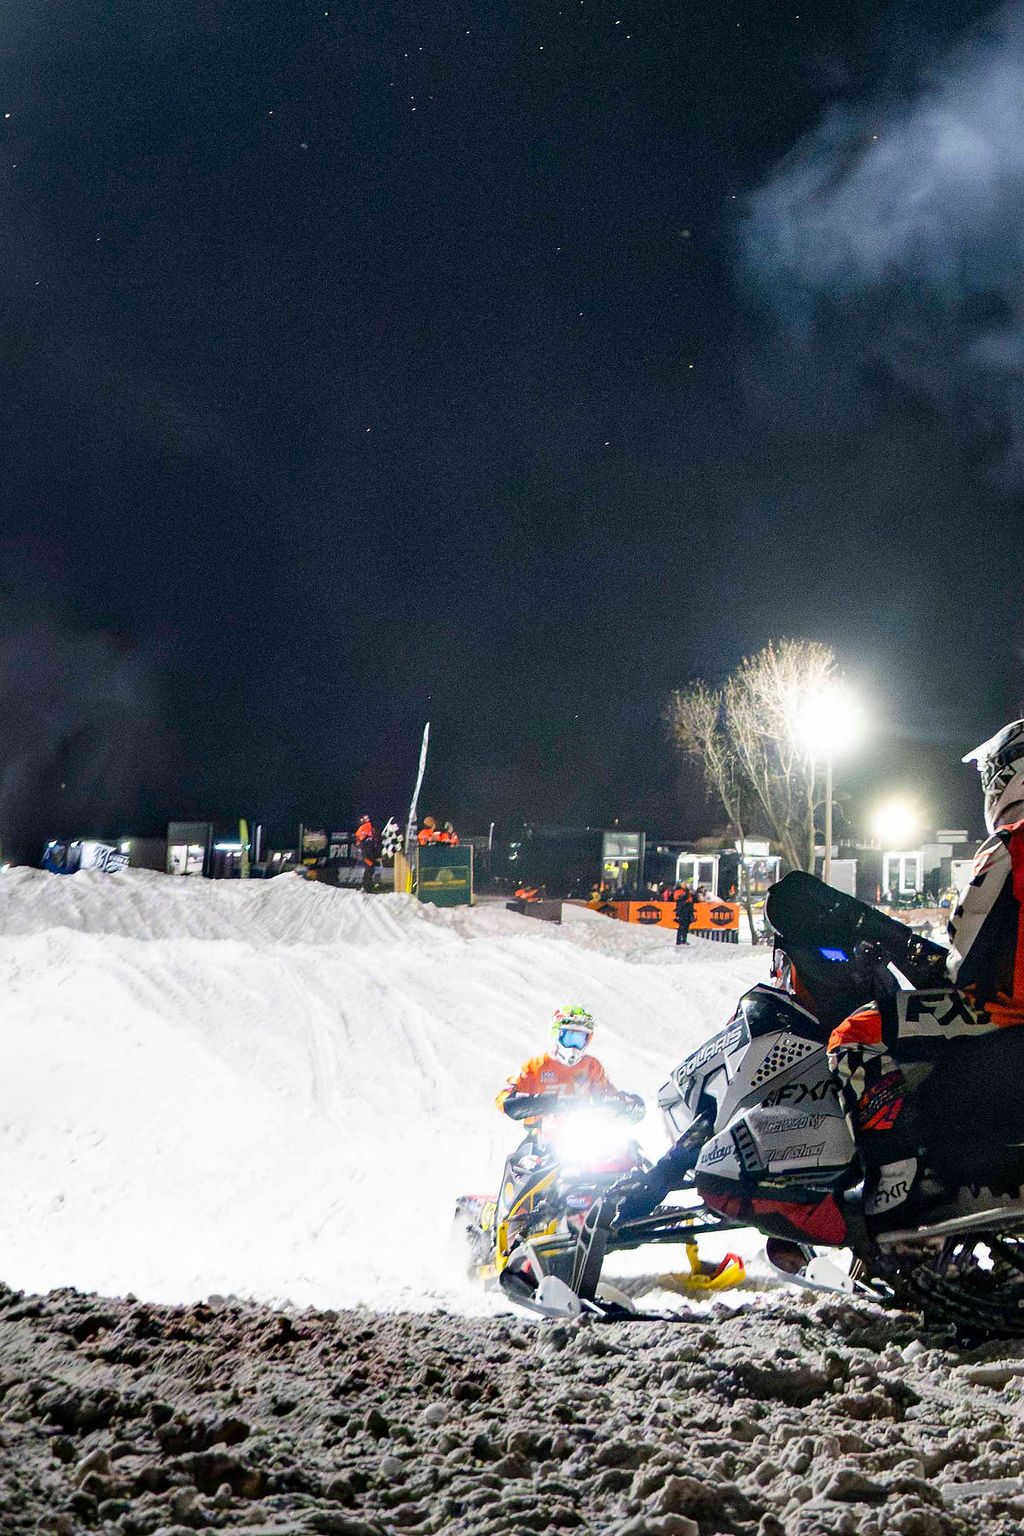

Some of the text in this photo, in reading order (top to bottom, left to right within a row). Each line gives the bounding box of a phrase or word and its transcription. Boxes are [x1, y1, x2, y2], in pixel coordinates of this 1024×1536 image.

[906, 993, 990, 1025] FX
[677, 1025, 743, 1086] POLARIS
[873, 1181, 910, 1207] FXR
